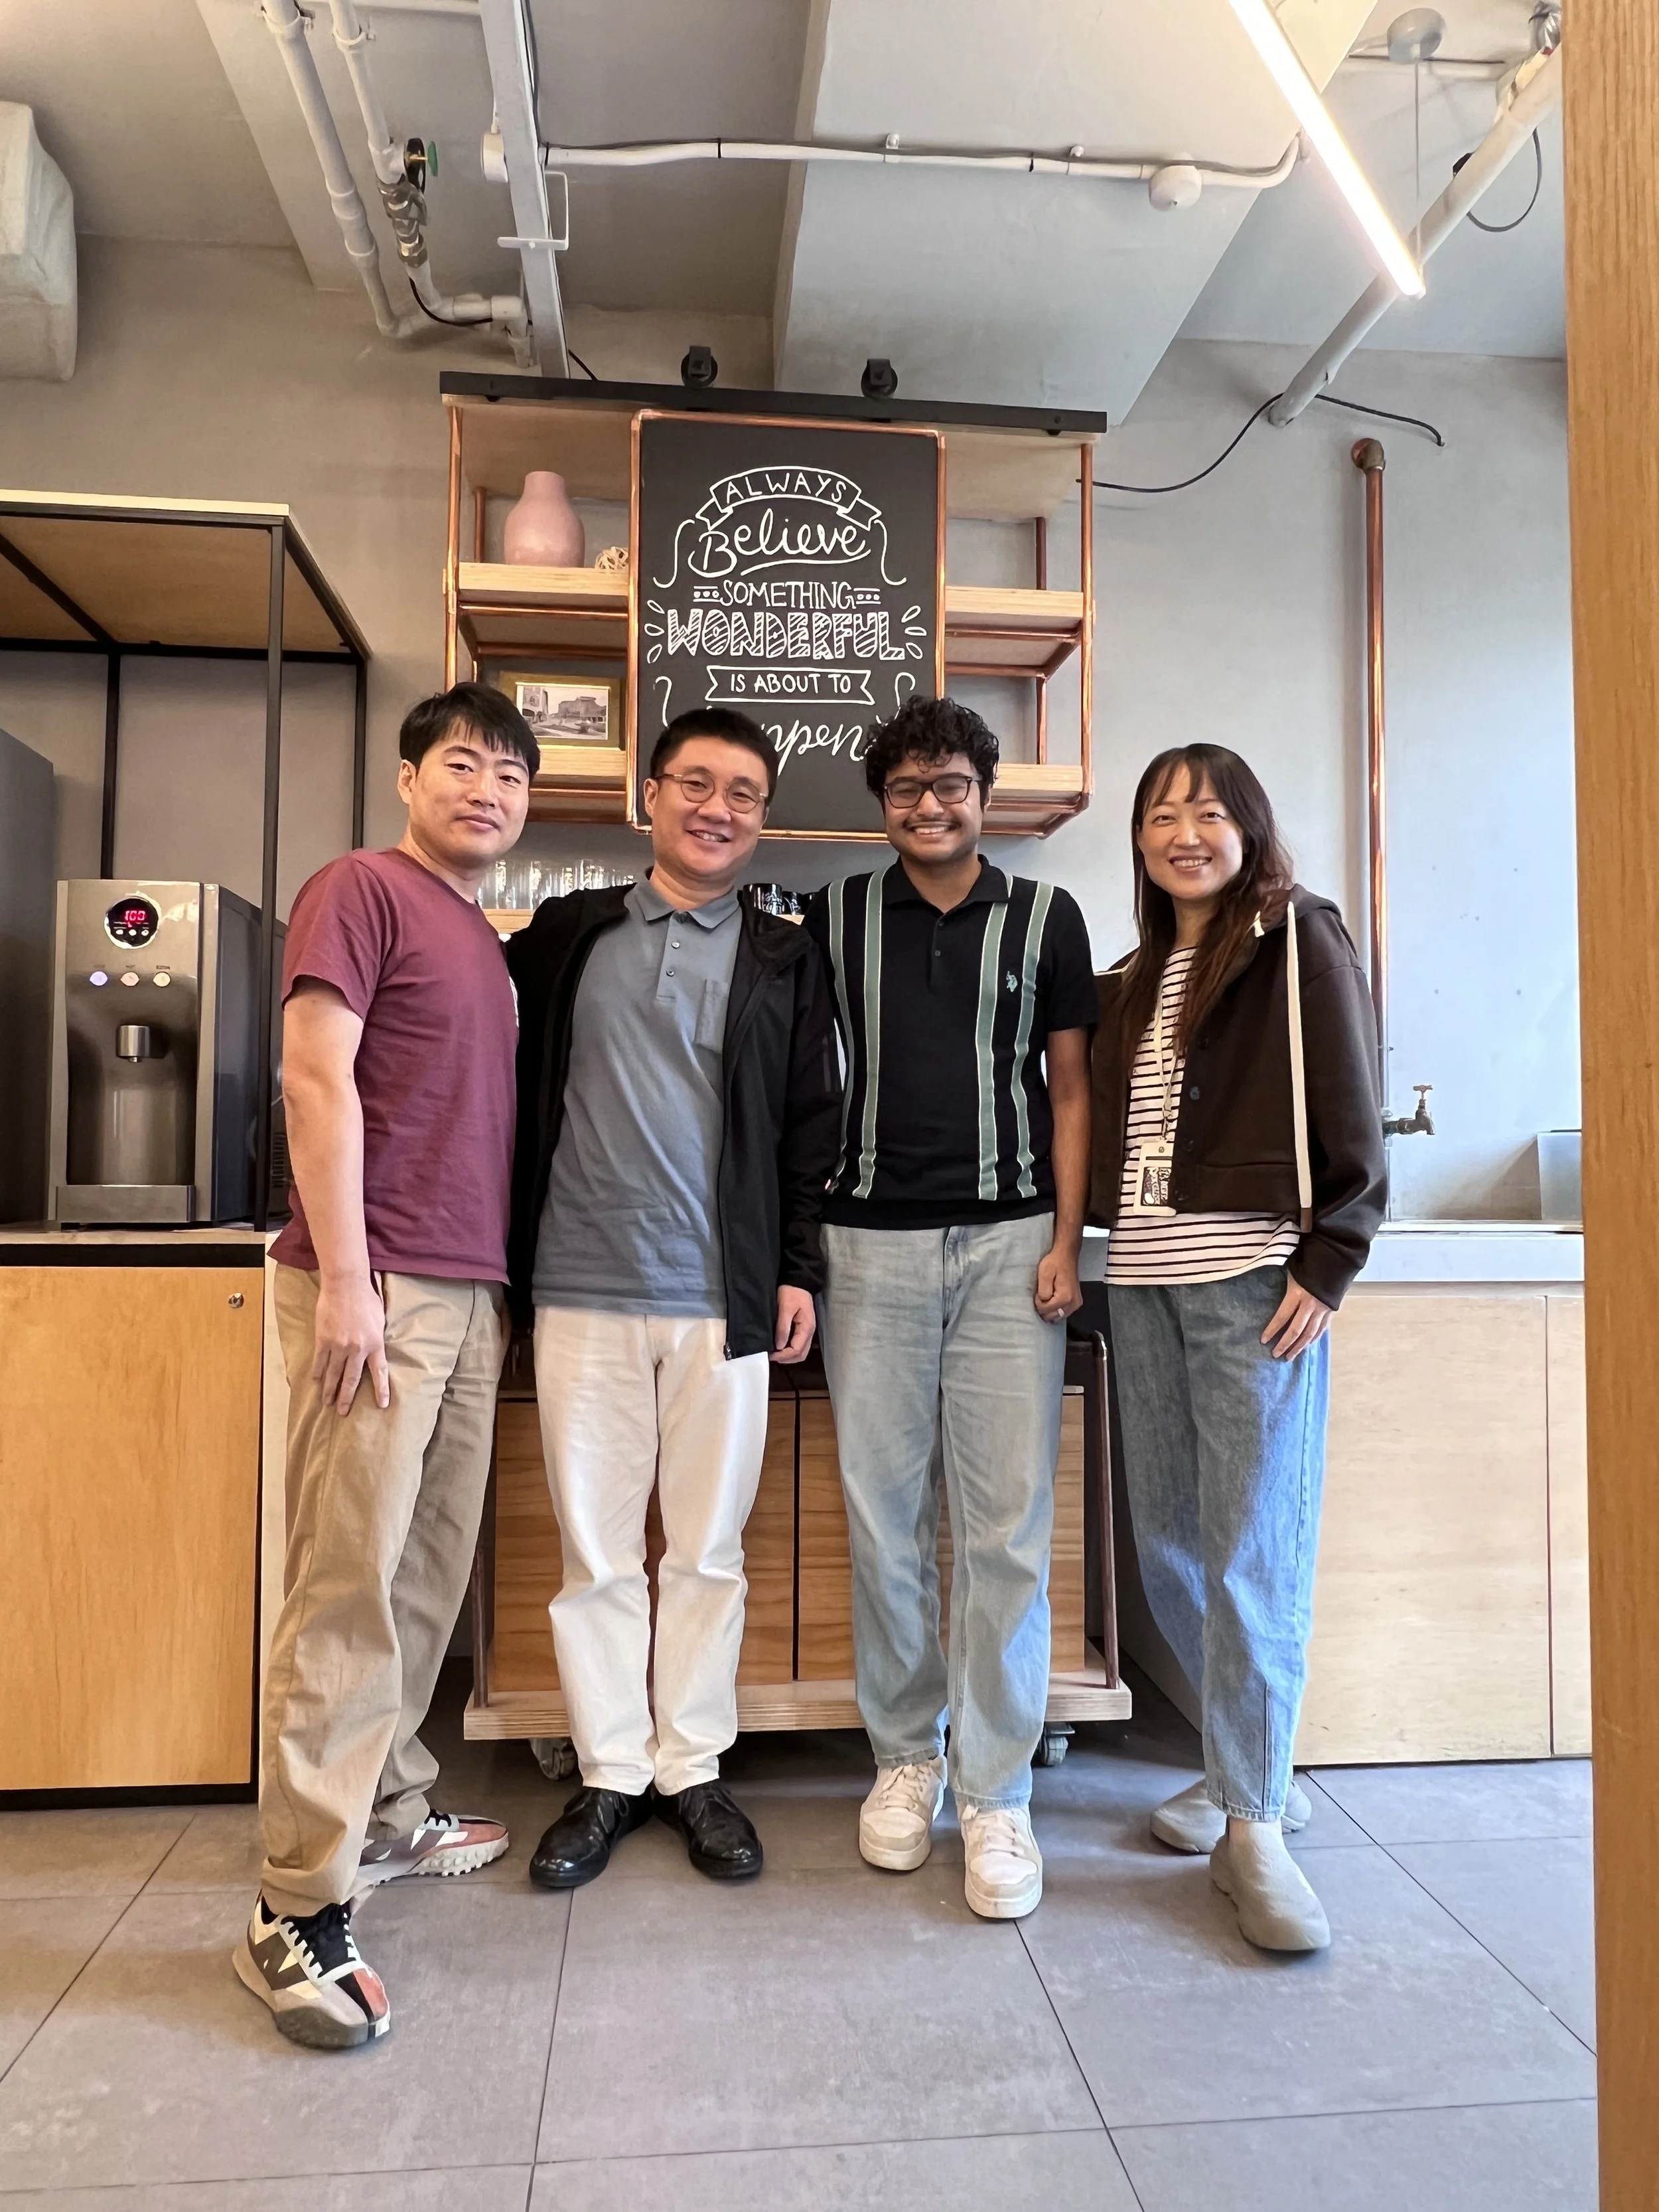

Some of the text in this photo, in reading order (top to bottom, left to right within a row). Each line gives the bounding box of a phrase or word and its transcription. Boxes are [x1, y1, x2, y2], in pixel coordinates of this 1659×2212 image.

[726, 472, 847, 504] ALWAYS
[688, 508, 865, 577] Believe
[719, 580, 856, 609] SOMETHING
[667, 608, 906, 661] WONDERFUL
[731, 673, 851, 694] IS ABOUT TO
